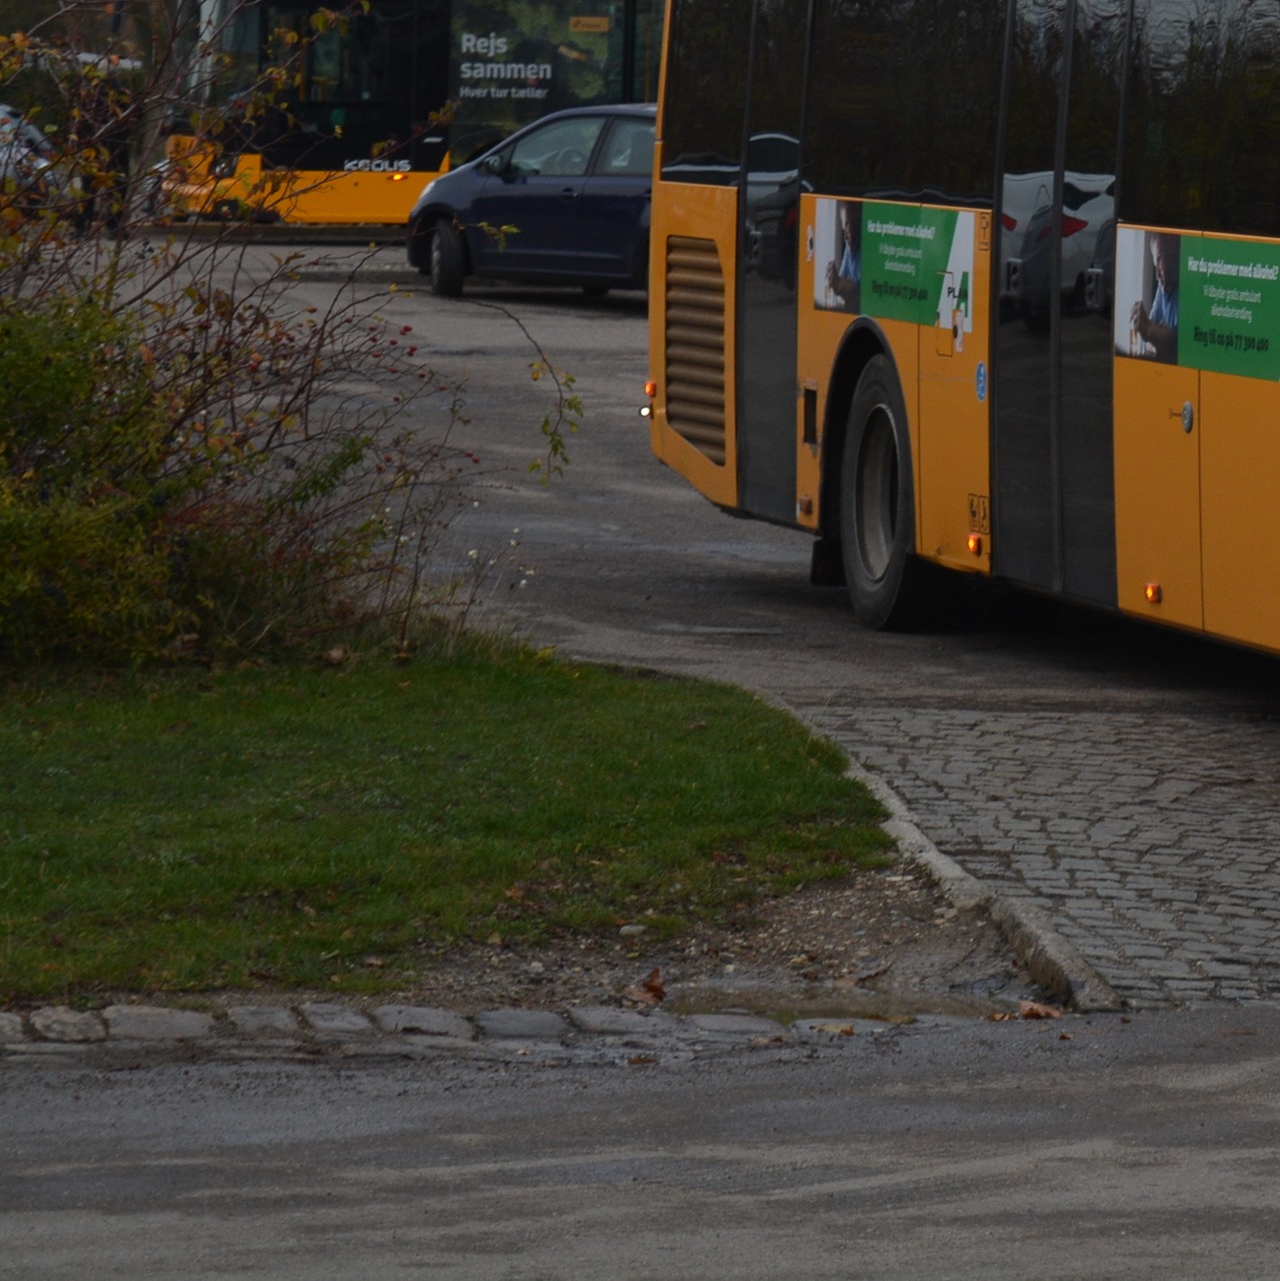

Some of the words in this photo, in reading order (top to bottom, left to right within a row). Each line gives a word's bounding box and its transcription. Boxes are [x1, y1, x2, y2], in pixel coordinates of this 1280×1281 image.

[460, 32, 508, 57] Rejs
[460, 62, 552, 79] sammen
[459, 86, 488, 98] Hver
[490, 87, 509, 98] tur
[1187, 256, 1199, 271] Har
[1199, 258, 1207, 272] du
[1207, 259, 1238, 277] problemer
[1238, 263, 1252, 277] med
[1252, 263, 1279, 280] alkohol?
